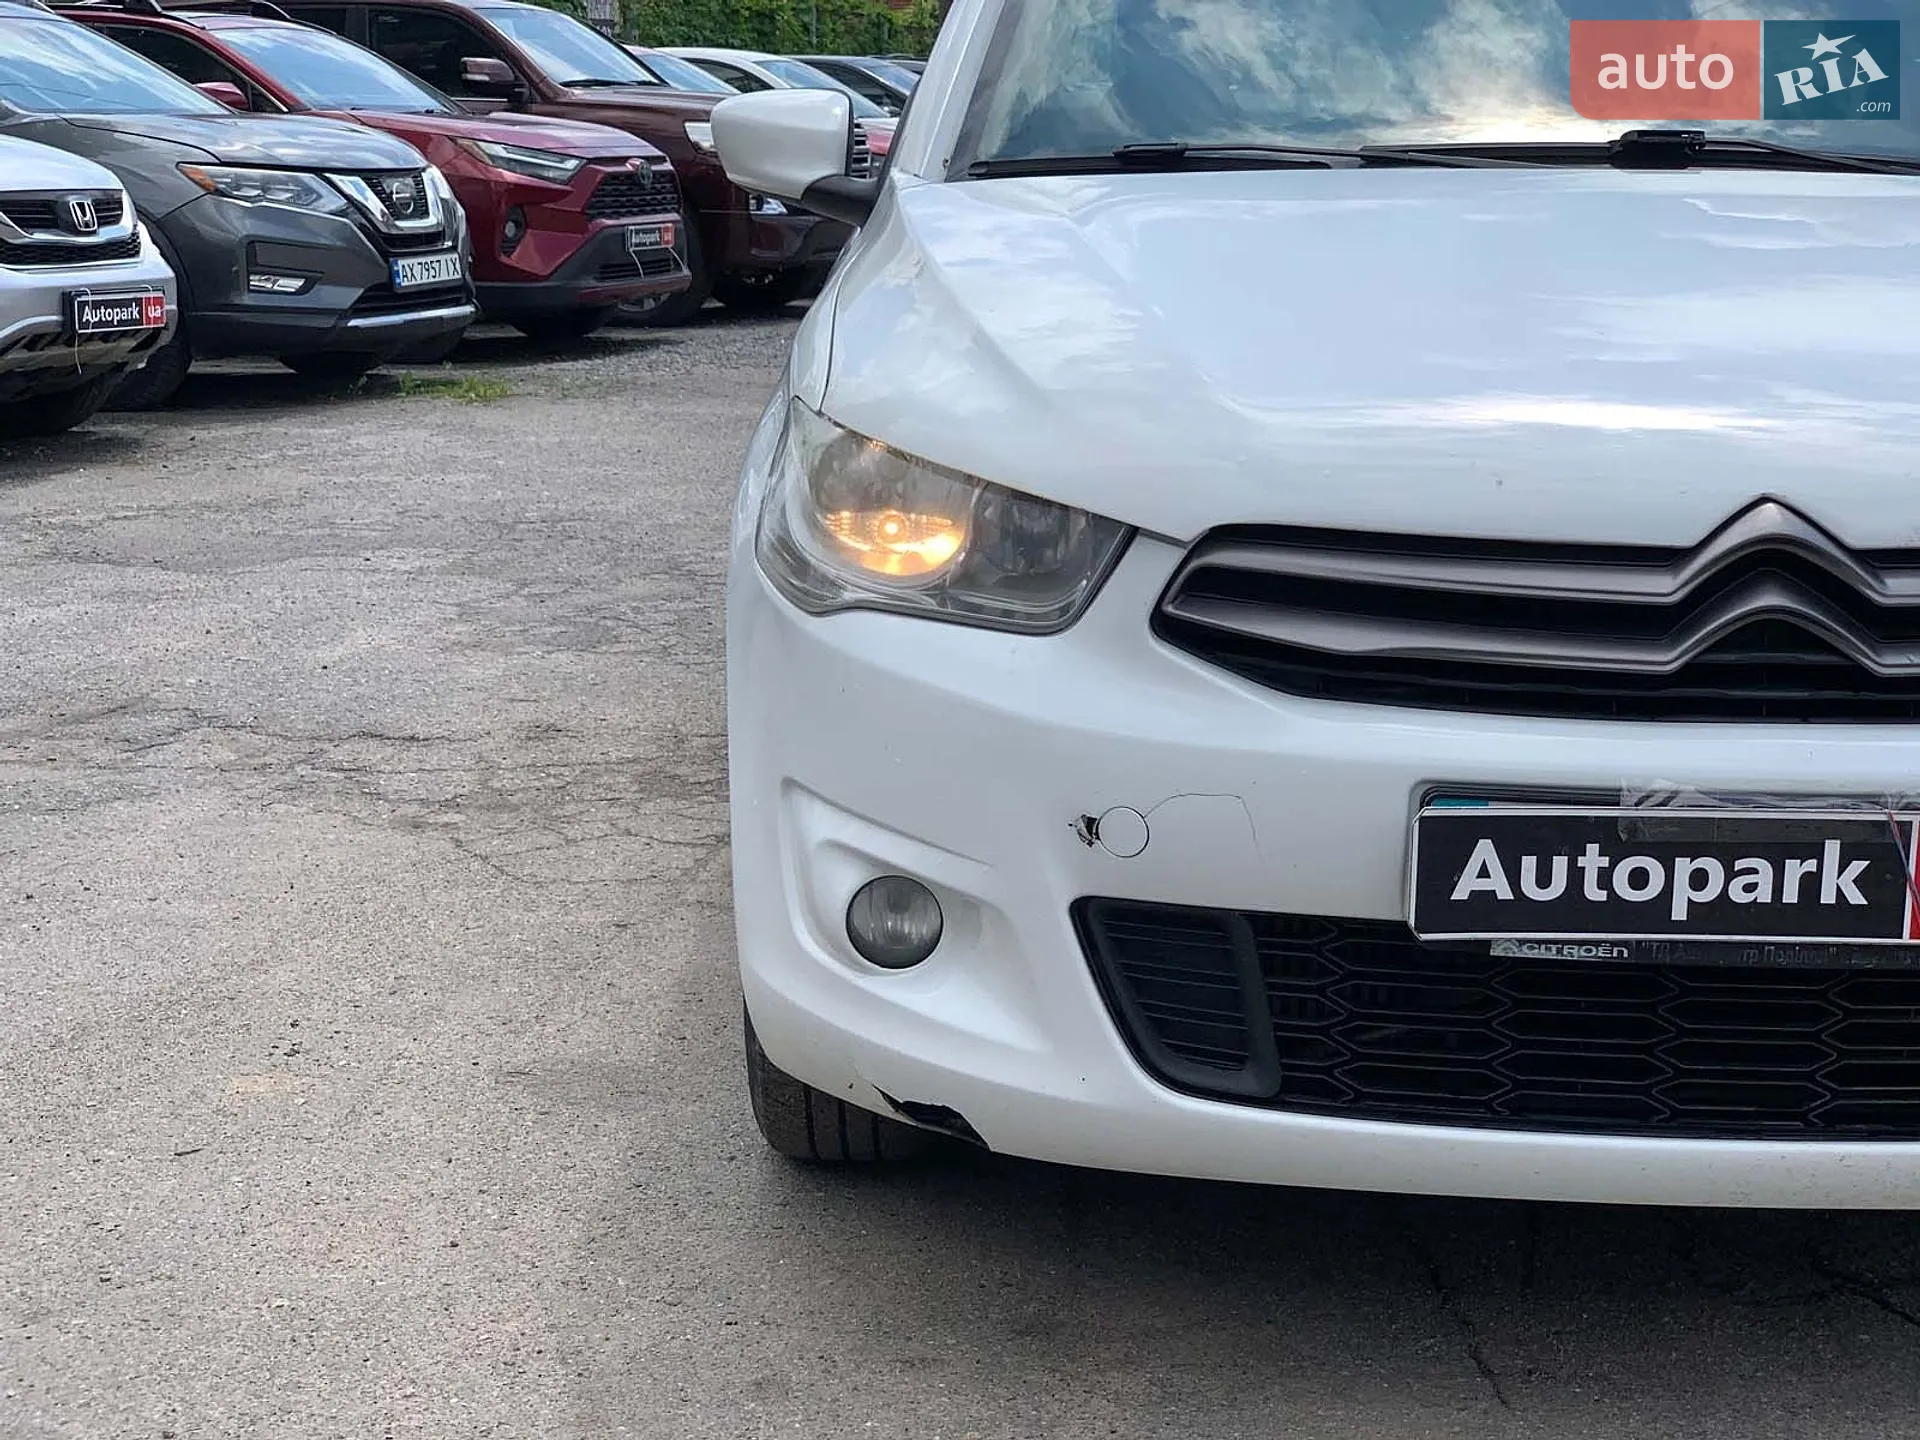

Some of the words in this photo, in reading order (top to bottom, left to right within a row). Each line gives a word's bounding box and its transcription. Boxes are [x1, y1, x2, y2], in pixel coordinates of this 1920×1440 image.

[401, 263, 417, 283] AX
[417, 259, 441, 280] 7957
[82, 301, 140, 326] Autopark
[147, 305, 161, 318] ua
[1449, 838, 1871, 921] Autopark
